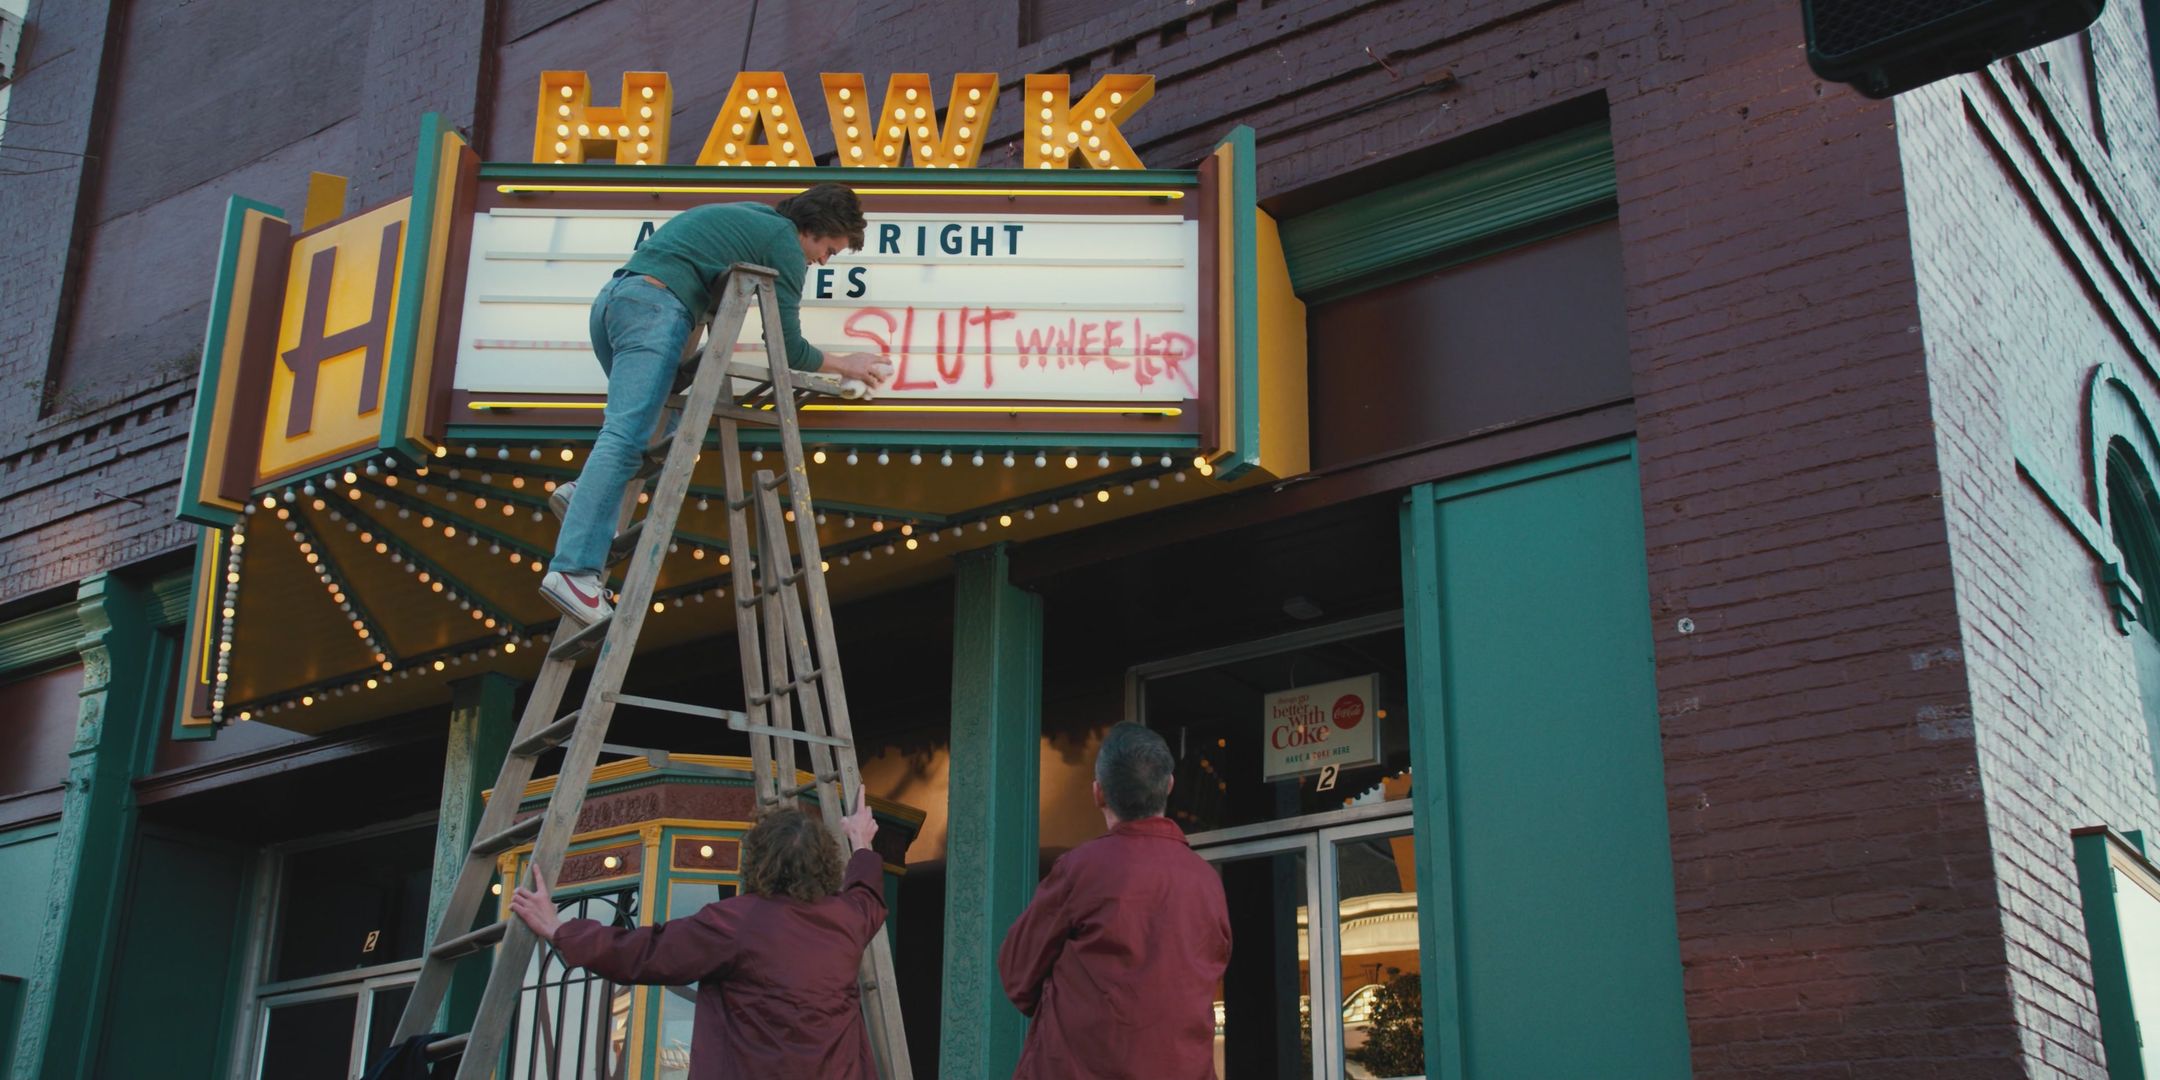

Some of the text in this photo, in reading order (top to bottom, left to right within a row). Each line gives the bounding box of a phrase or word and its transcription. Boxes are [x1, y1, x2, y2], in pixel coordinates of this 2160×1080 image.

[532, 70, 1155, 170] HAWK
[878, 223, 1024, 257] RIGHT
[803, 266, 868, 300] ES
[281, 219, 403, 440] H
[843, 305, 1199, 399] SLUT WHEELER
[1273, 703, 1309, 719] better
[1288, 705, 1326, 727] with
[1272, 725, 1329, 750] Coke
[1333, 745, 1351, 756] HERE
[1320, 767, 1335, 789] 2
[365, 932, 377, 950] 2
